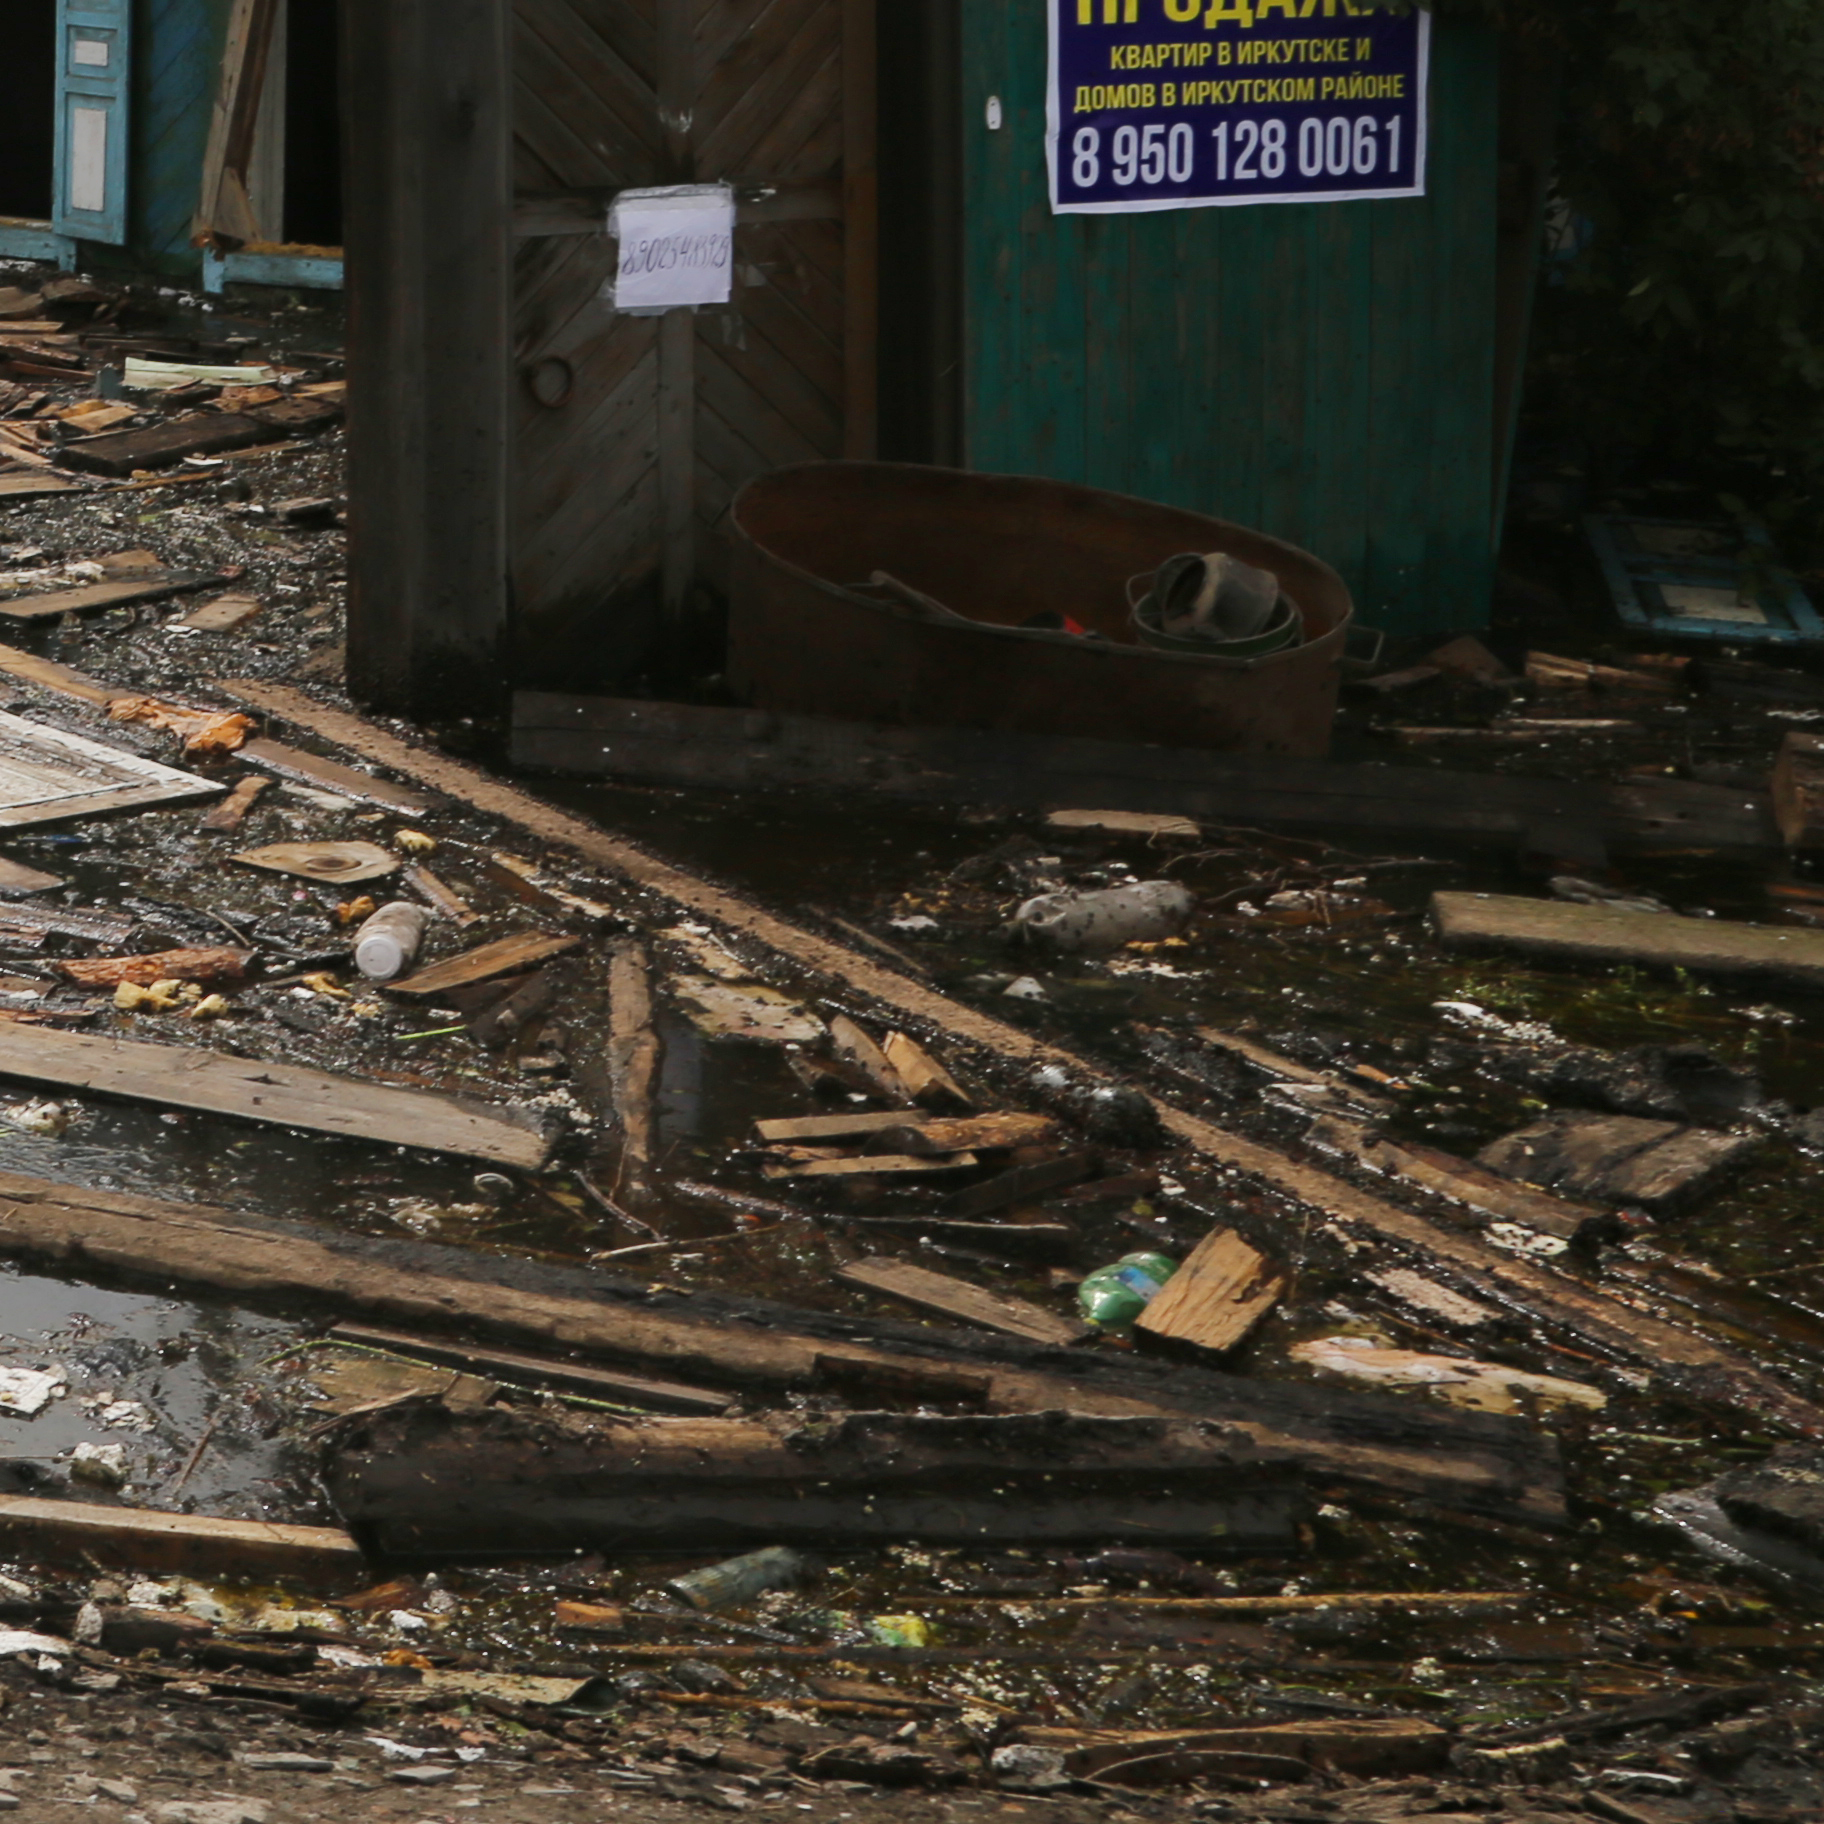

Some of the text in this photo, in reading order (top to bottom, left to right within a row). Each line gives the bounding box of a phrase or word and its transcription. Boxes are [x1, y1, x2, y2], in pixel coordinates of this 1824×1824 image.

[1110, 37, 1371, 70] КВАРТИР В ИРКУТСКЕ И
[1072, 71, 1405, 114] ДОМОВ В ИРКУТСКОМ РАЙОНЕ
[1072, 115, 1402, 188] 8 950 128 0061
